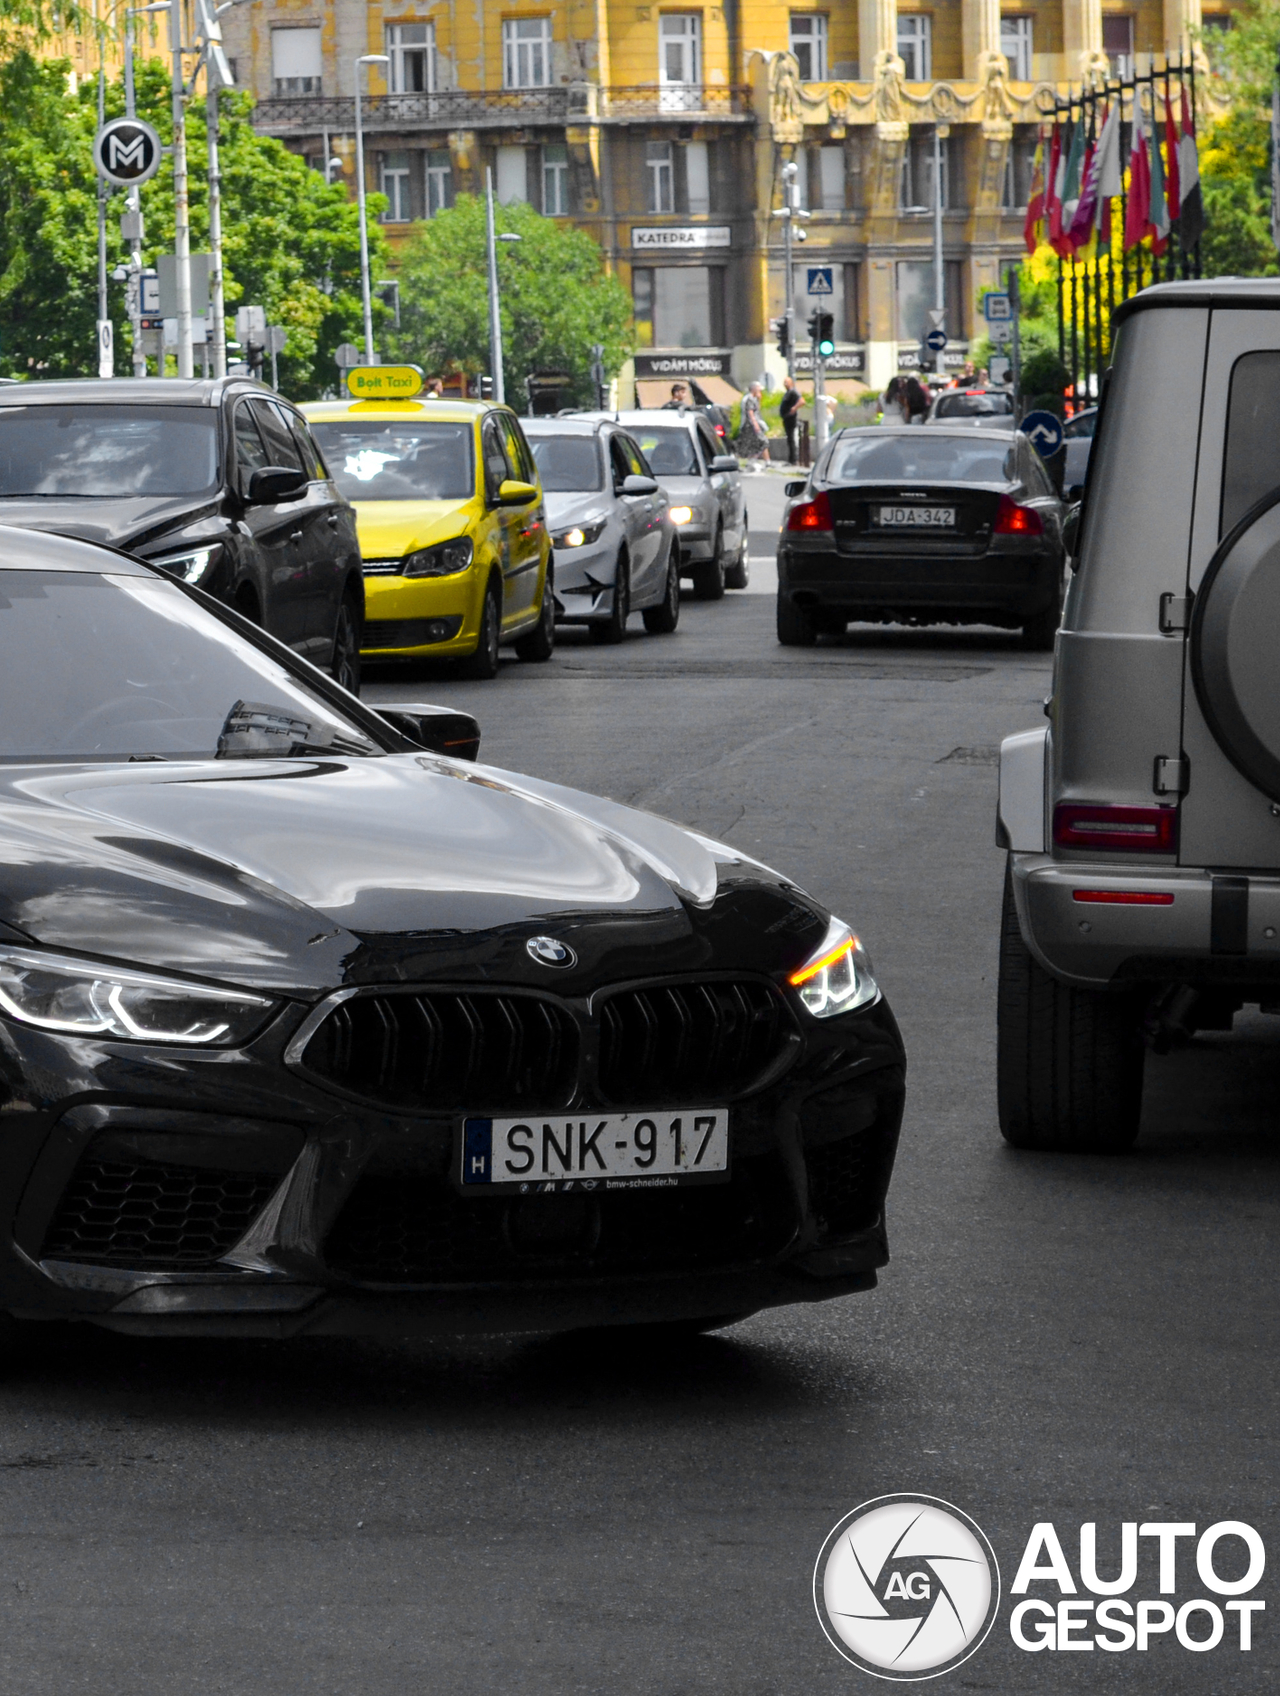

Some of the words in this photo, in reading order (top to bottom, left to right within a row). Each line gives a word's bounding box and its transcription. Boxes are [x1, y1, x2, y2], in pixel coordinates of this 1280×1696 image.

[637, 232, 696, 243] KATEDRA
[357, 376, 382, 391] Bolt
[386, 375, 412, 387] Taxi
[883, 509, 951, 523] JDA-342
[504, 1116, 717, 1175] SNK-917
[471, 1156, 485, 1174] H
[606, 1177, 679, 1189] bmw-schneider.hu
